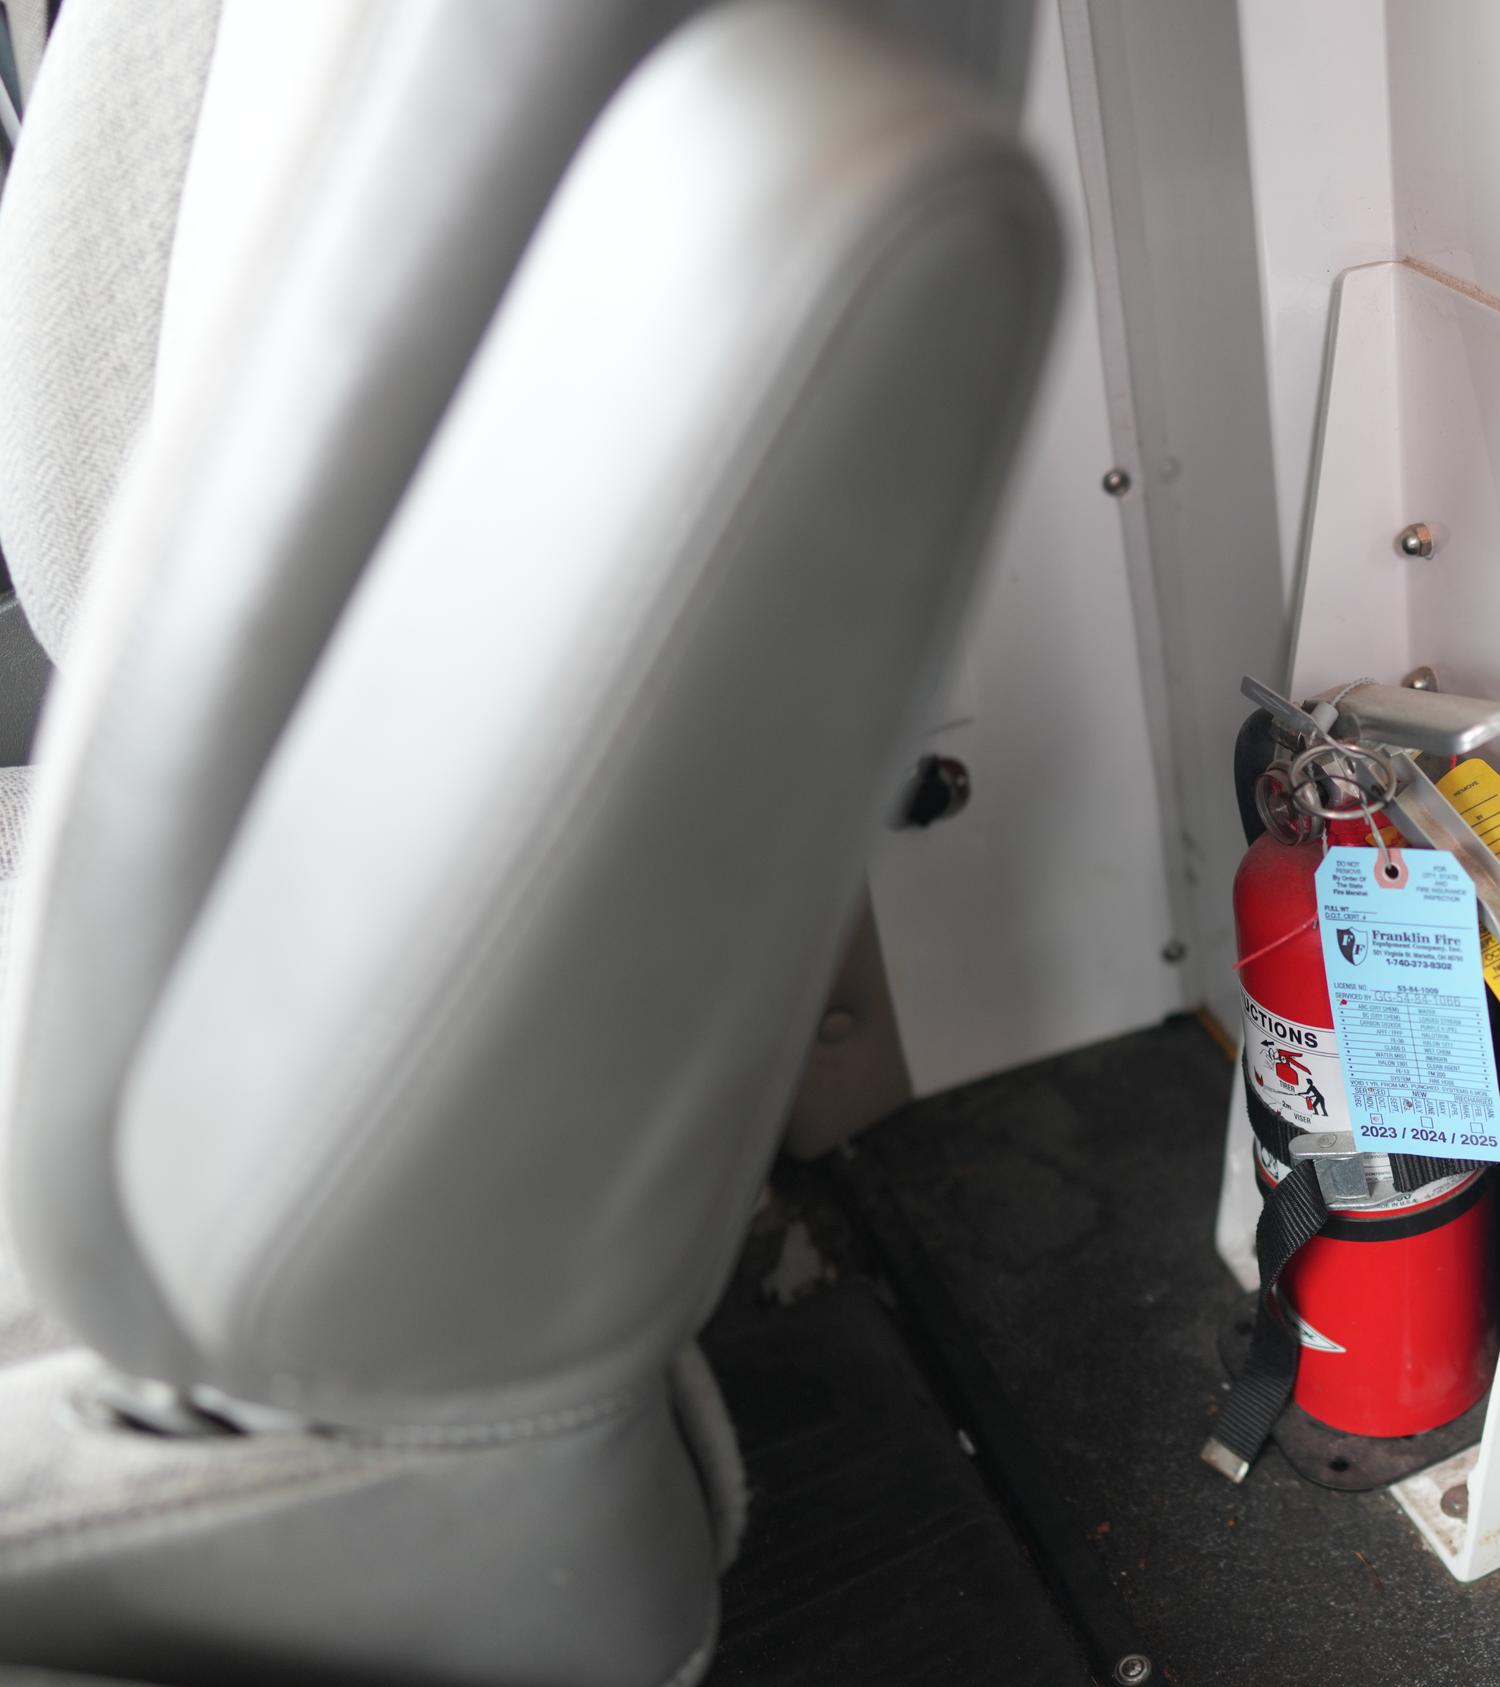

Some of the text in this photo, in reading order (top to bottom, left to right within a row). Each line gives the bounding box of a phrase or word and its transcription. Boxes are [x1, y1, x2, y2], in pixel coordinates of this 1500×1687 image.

[1372, 930, 1461, 946] Franklin Fire
[1372, 940, 1410, 949] Equipment
[1386, 958, 1452, 970] 1-740-373-8302
[1335, 992, 1362, 1000] SERVICED
[1242, 993, 1318, 1048] UCTIONS
[1280, 1080, 1296, 1092] TIRER
[1282, 1100, 1292, 1110] 2m
[1294, 1113, 1312, 1124] VISER
[1360, 1126, 1498, 1148] 2023 / 2024 / 2025
